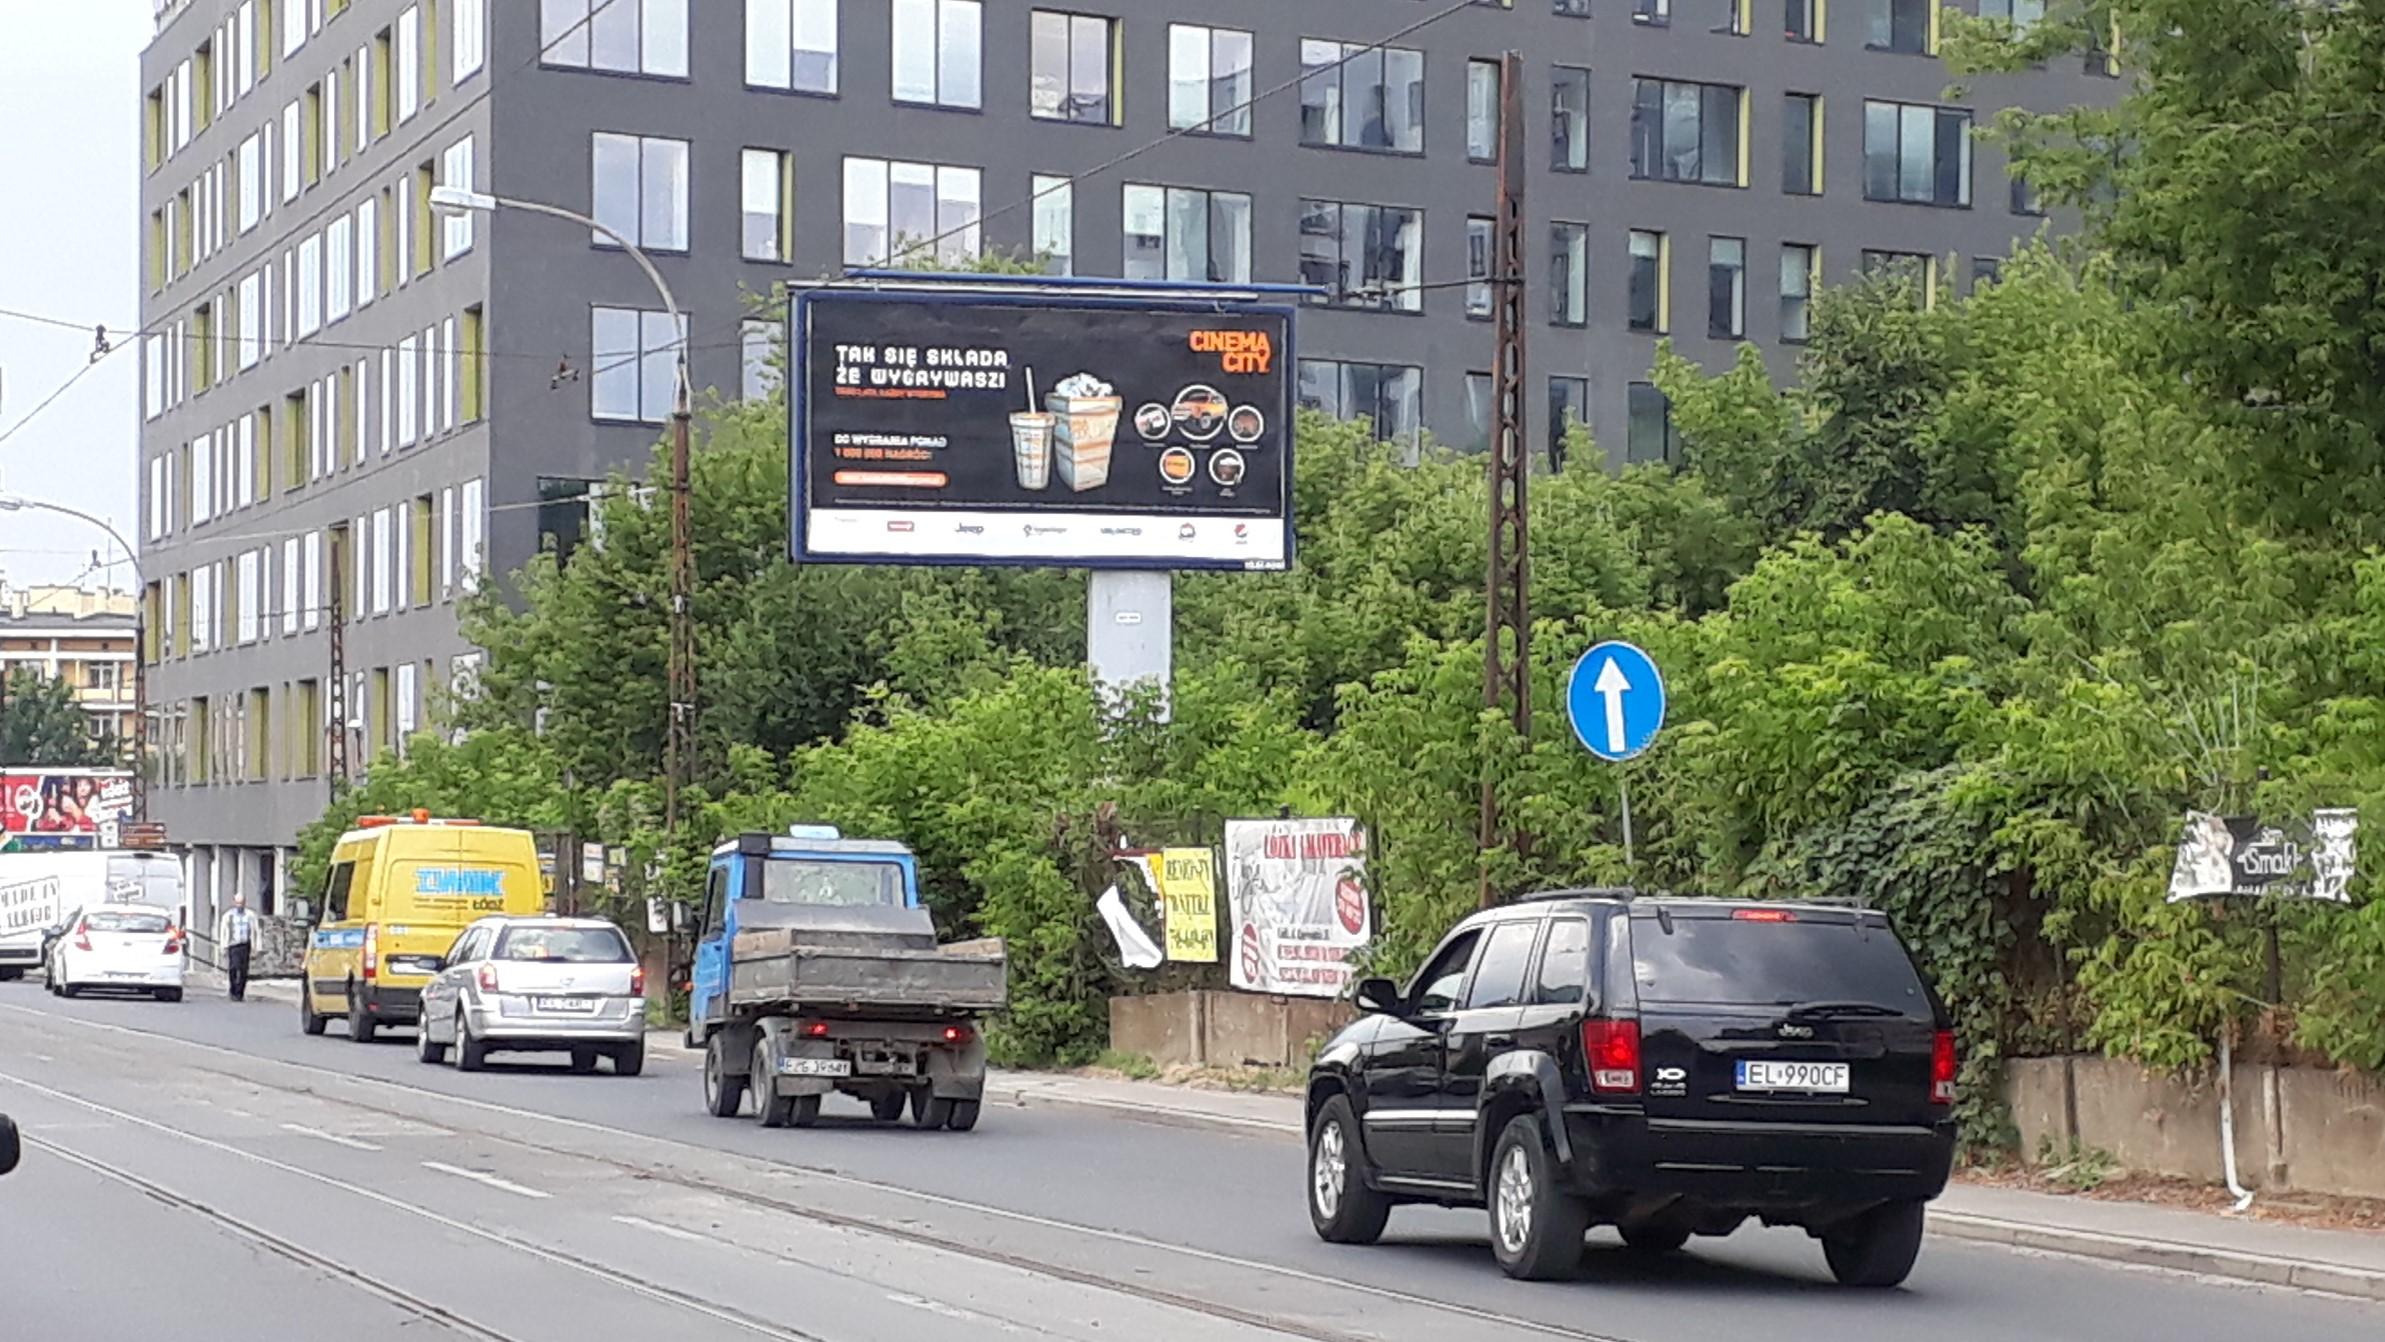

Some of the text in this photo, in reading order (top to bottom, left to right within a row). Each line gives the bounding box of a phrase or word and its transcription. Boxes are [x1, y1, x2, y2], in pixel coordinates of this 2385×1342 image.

[1190, 331, 1269, 352] CINEMA
[836, 345, 875, 363] TAK
[885, 347, 917, 368] SIĘ
[1222, 351, 1271, 373] CITY
[836, 363, 861, 384] ŻE
[1750, 1064, 1846, 1086] EL 990CF
